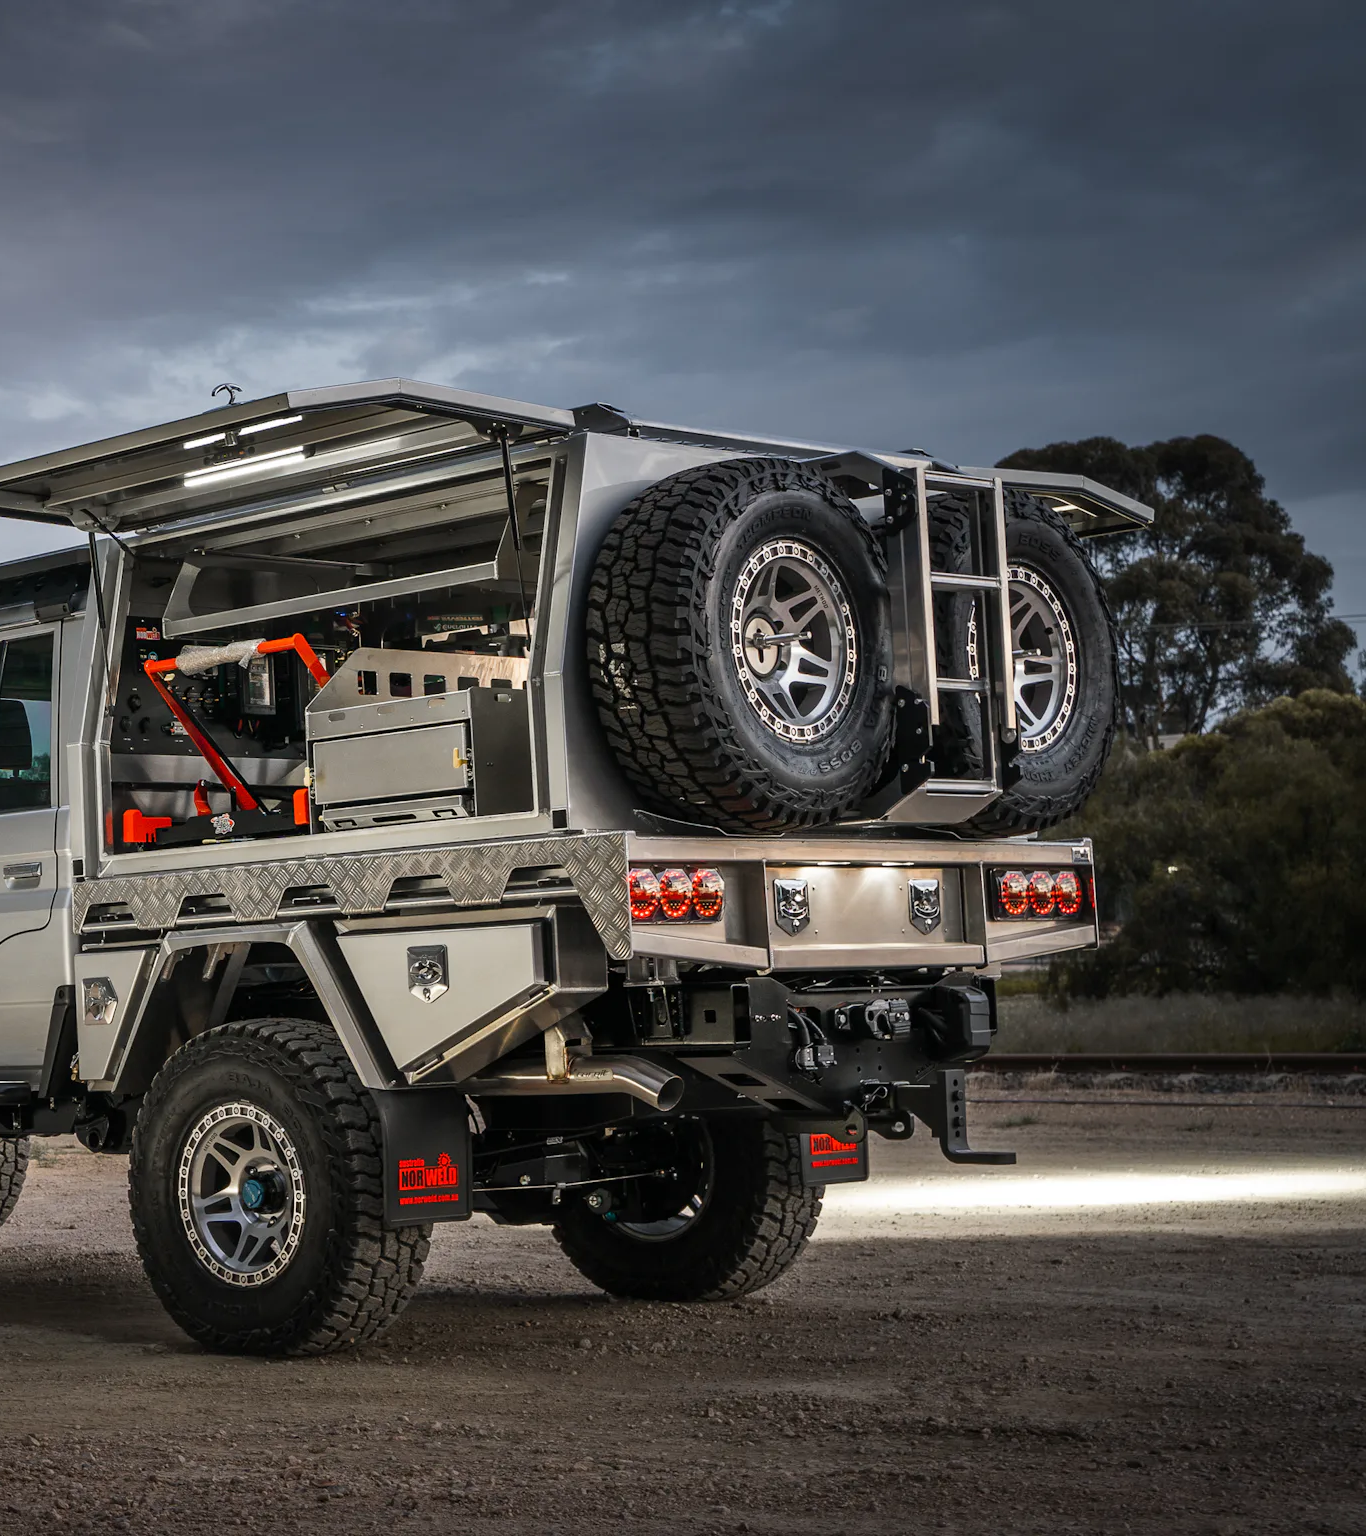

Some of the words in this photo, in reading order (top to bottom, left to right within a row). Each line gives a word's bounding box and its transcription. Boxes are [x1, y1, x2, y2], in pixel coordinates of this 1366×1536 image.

[1019, 532, 1061, 562] BOSS
[814, 585, 829, 609] METHOD
[818, 740, 862, 773] BOSS
[203, 1132, 218, 1152] METHOD
[401, 1166, 457, 1188] NORWELD
